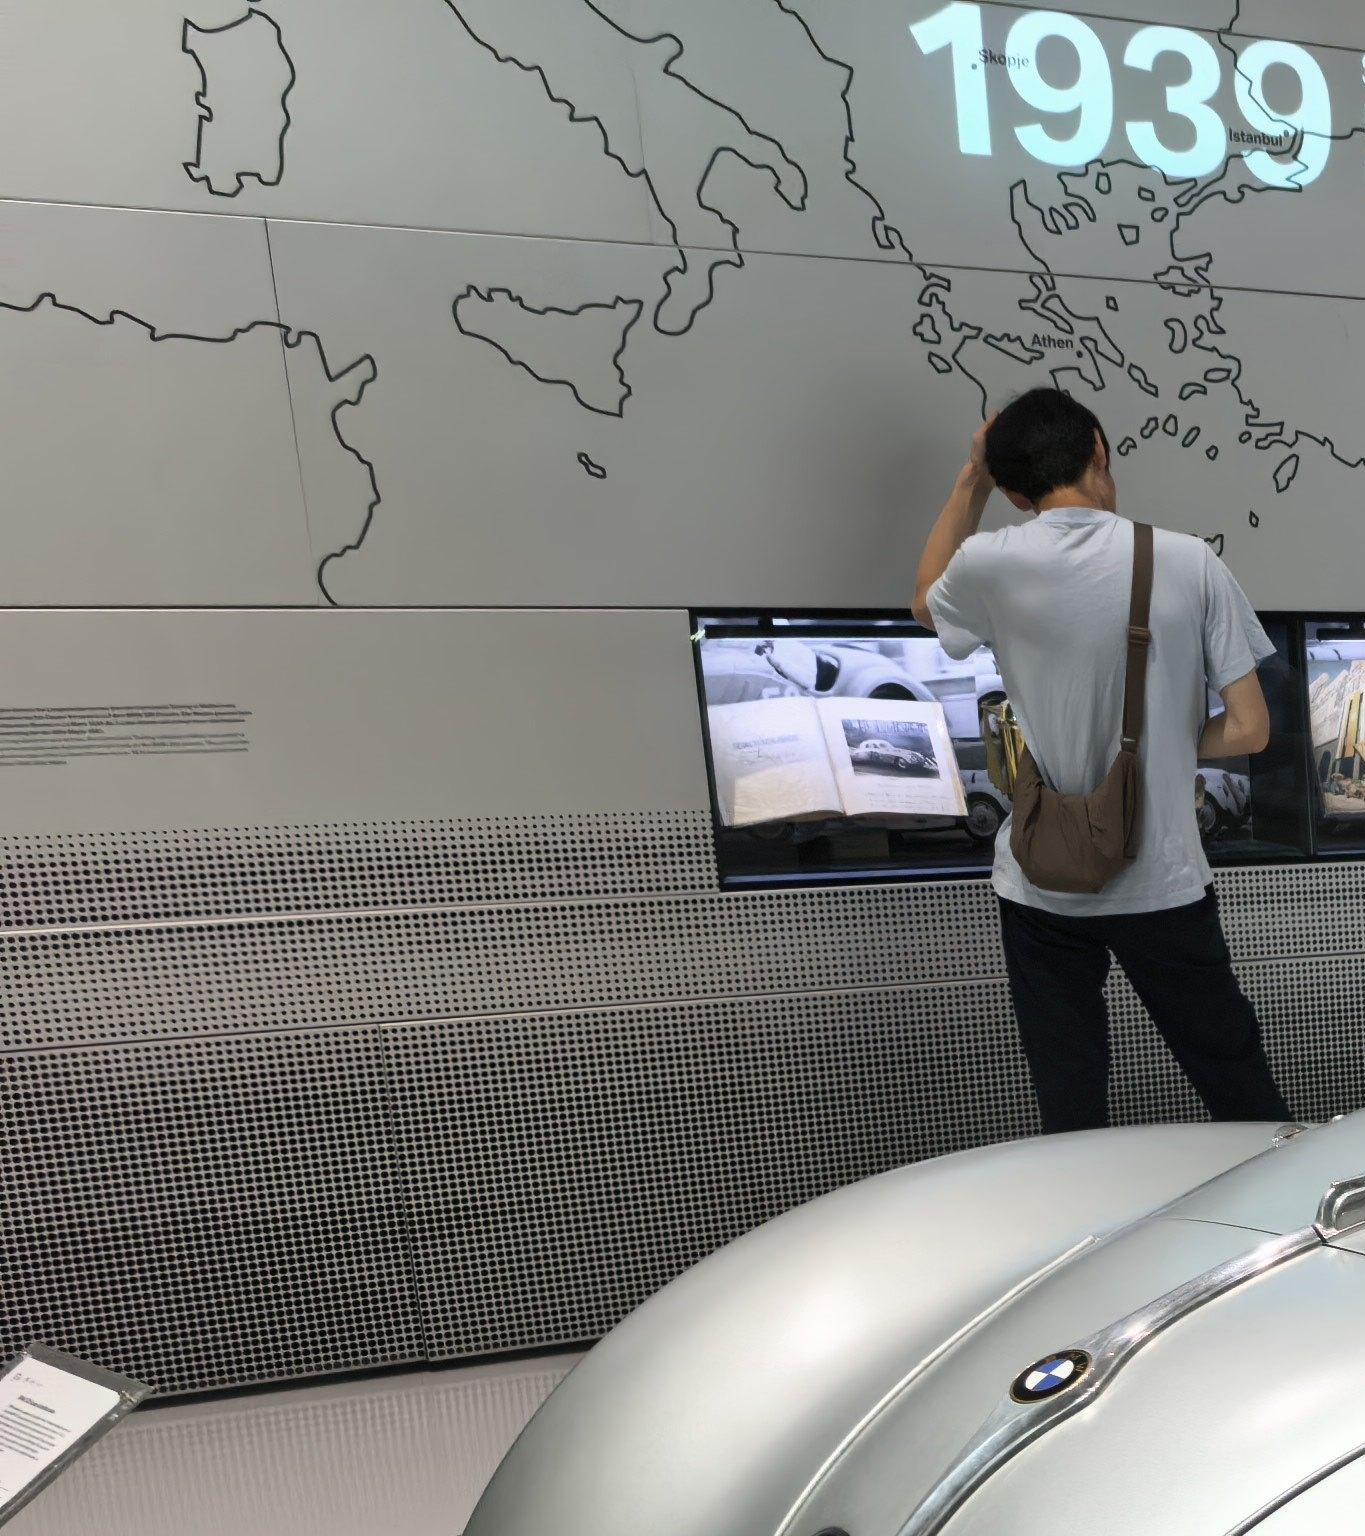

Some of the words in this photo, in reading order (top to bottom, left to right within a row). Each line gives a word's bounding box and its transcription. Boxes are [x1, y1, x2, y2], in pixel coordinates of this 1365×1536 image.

[909, 0, 1332, 190] 1939
[1229, 126, 1283, 146] Istanbul
[1031, 332, 1074, 349] Athen
